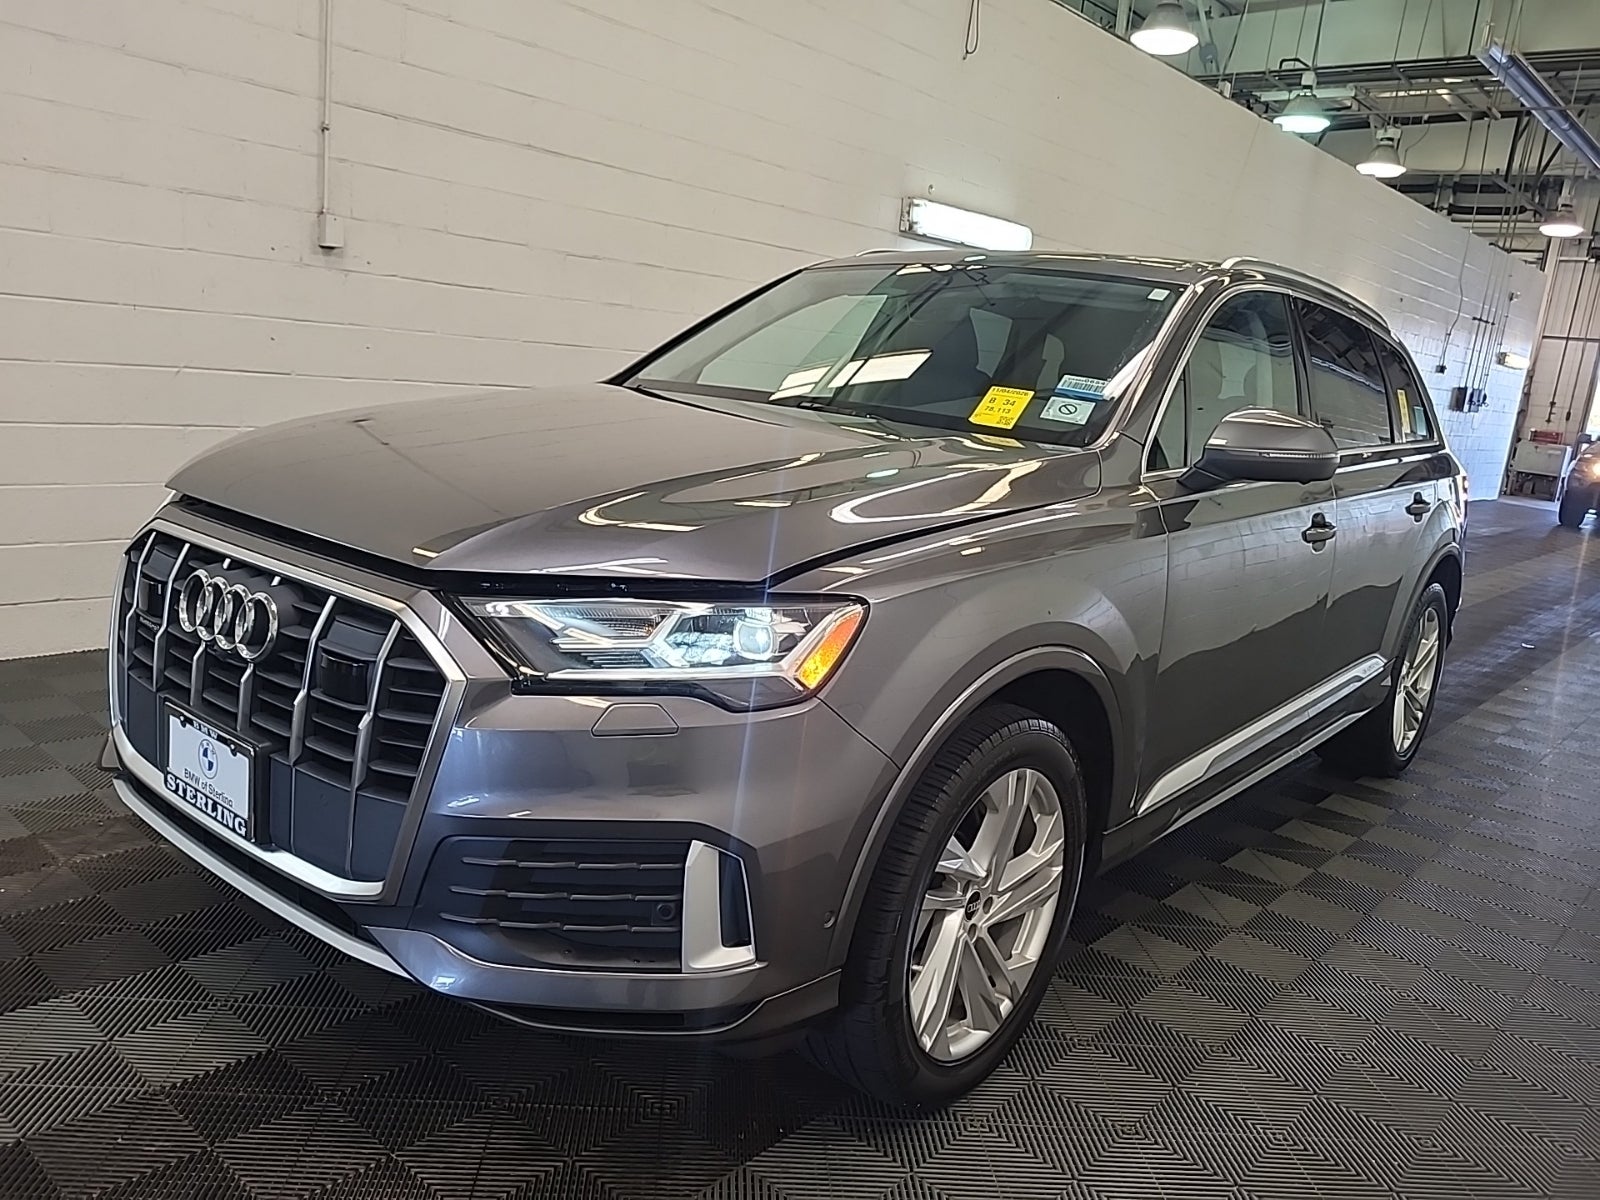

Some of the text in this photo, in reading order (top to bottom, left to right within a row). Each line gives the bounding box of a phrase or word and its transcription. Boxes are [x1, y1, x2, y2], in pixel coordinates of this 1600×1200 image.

[1002, 398, 1017, 407] 34
[193, 720, 219, 740] BMW
[184, 768, 200, 786] BMW
[201, 779, 208, 790] of
[166, 773, 247, 837] STERLING
